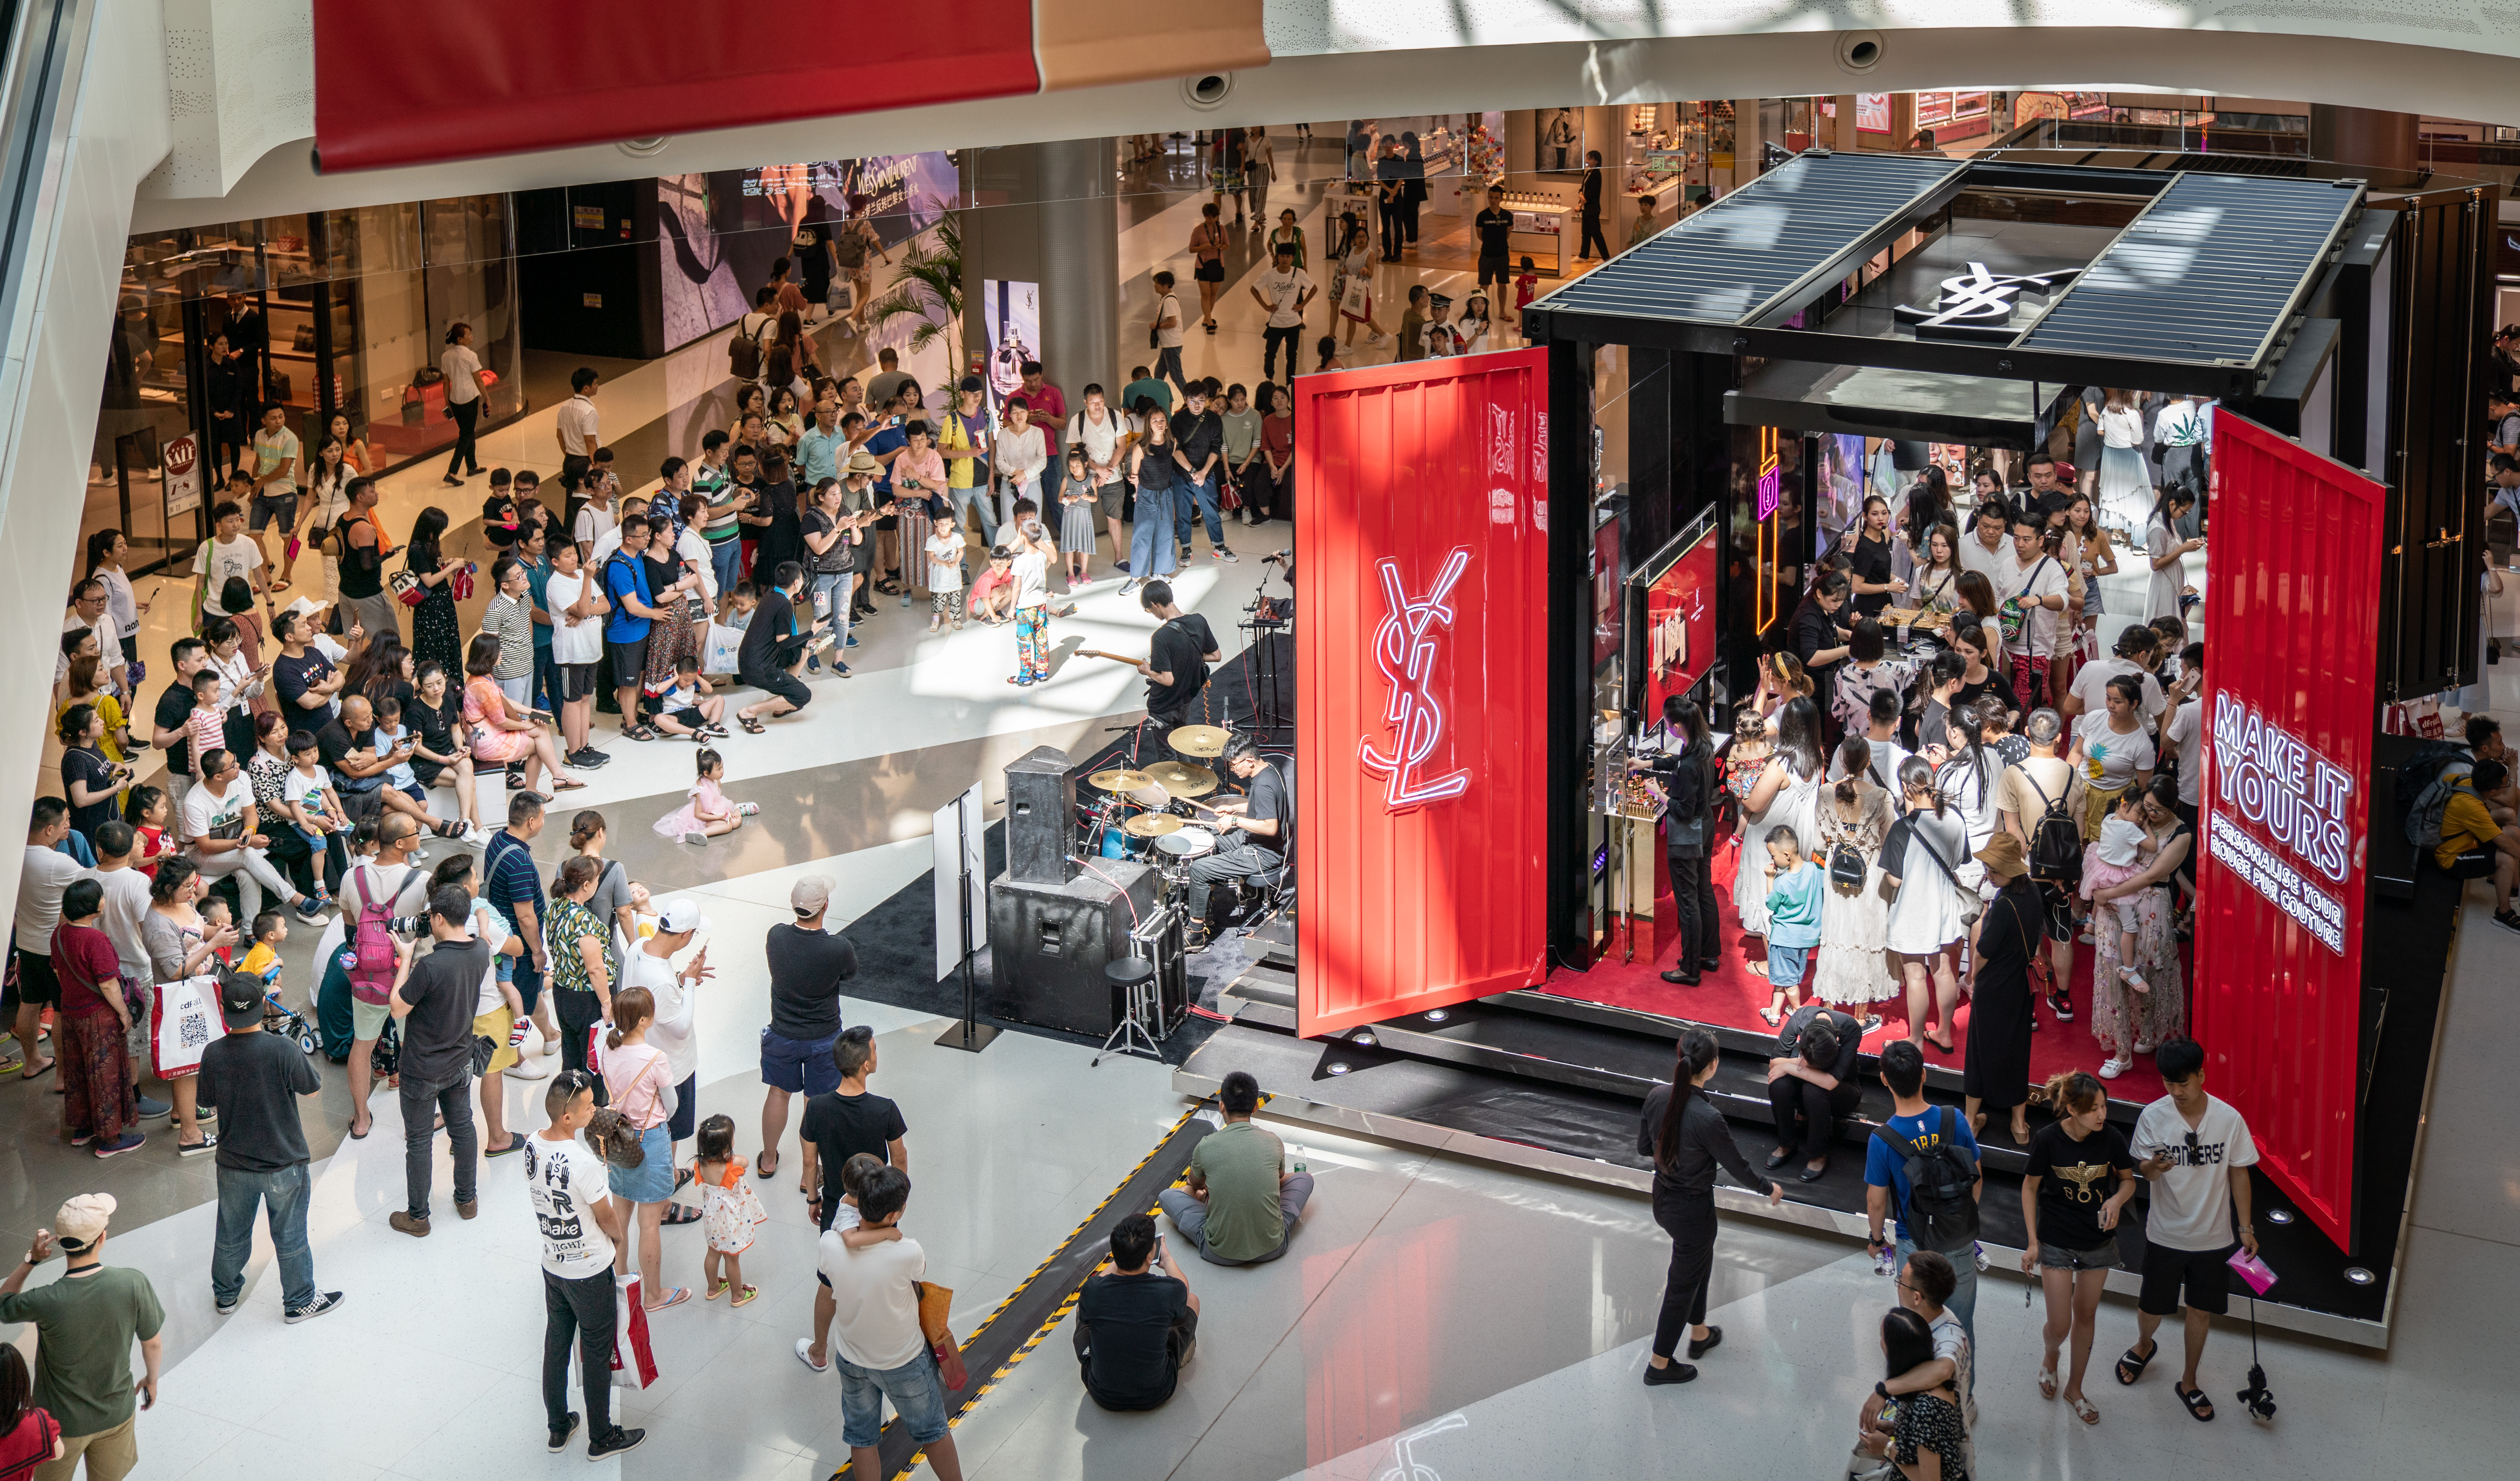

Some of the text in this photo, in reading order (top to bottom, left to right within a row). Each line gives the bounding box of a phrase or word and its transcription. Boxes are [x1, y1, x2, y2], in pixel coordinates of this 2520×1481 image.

[165, 444, 195, 469] SALE
[499, 503, 512, 515] FANTAS
[2002, 607, 2021, 616] Discovery
[1362, 552, 1467, 805] YSL
[2214, 694, 2350, 820] MAKE IT
[2214, 740, 2347, 881] YOURS
[2211, 812, 2341, 928] PERSONALISE YOUR
[2211, 835, 2341, 952] ROUGE PUR COUTURE
[180, 997, 202, 1010] cdfall
[2168, 1142, 2224, 1167] ONERSE
[554, 1164, 561, 1173] S
[530, 1187, 541, 1195] Club
[2063, 1187, 2103, 1203] BOY
